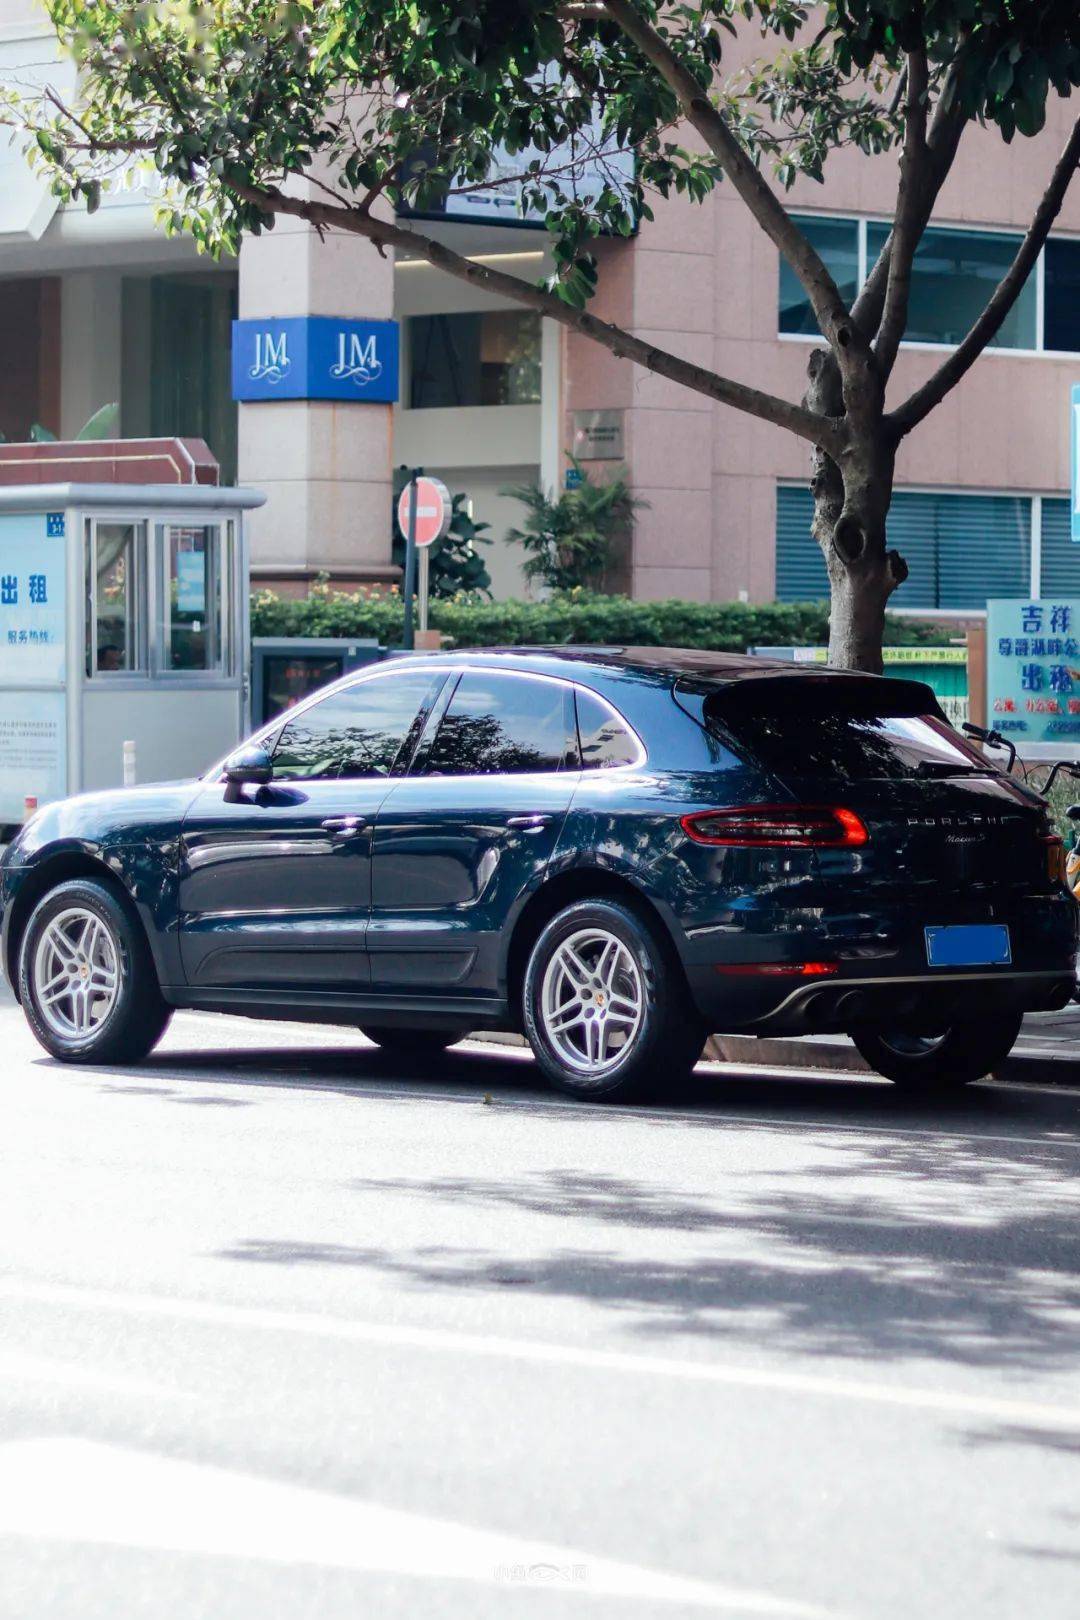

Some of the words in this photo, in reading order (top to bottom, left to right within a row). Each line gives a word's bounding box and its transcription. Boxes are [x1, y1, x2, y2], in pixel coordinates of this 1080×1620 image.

[250, 332, 289, 379] JM
[331, 332, 380, 379] JM
[1, 575, 48, 604] 出租
[1021, 605, 1073, 633] 吉祥
